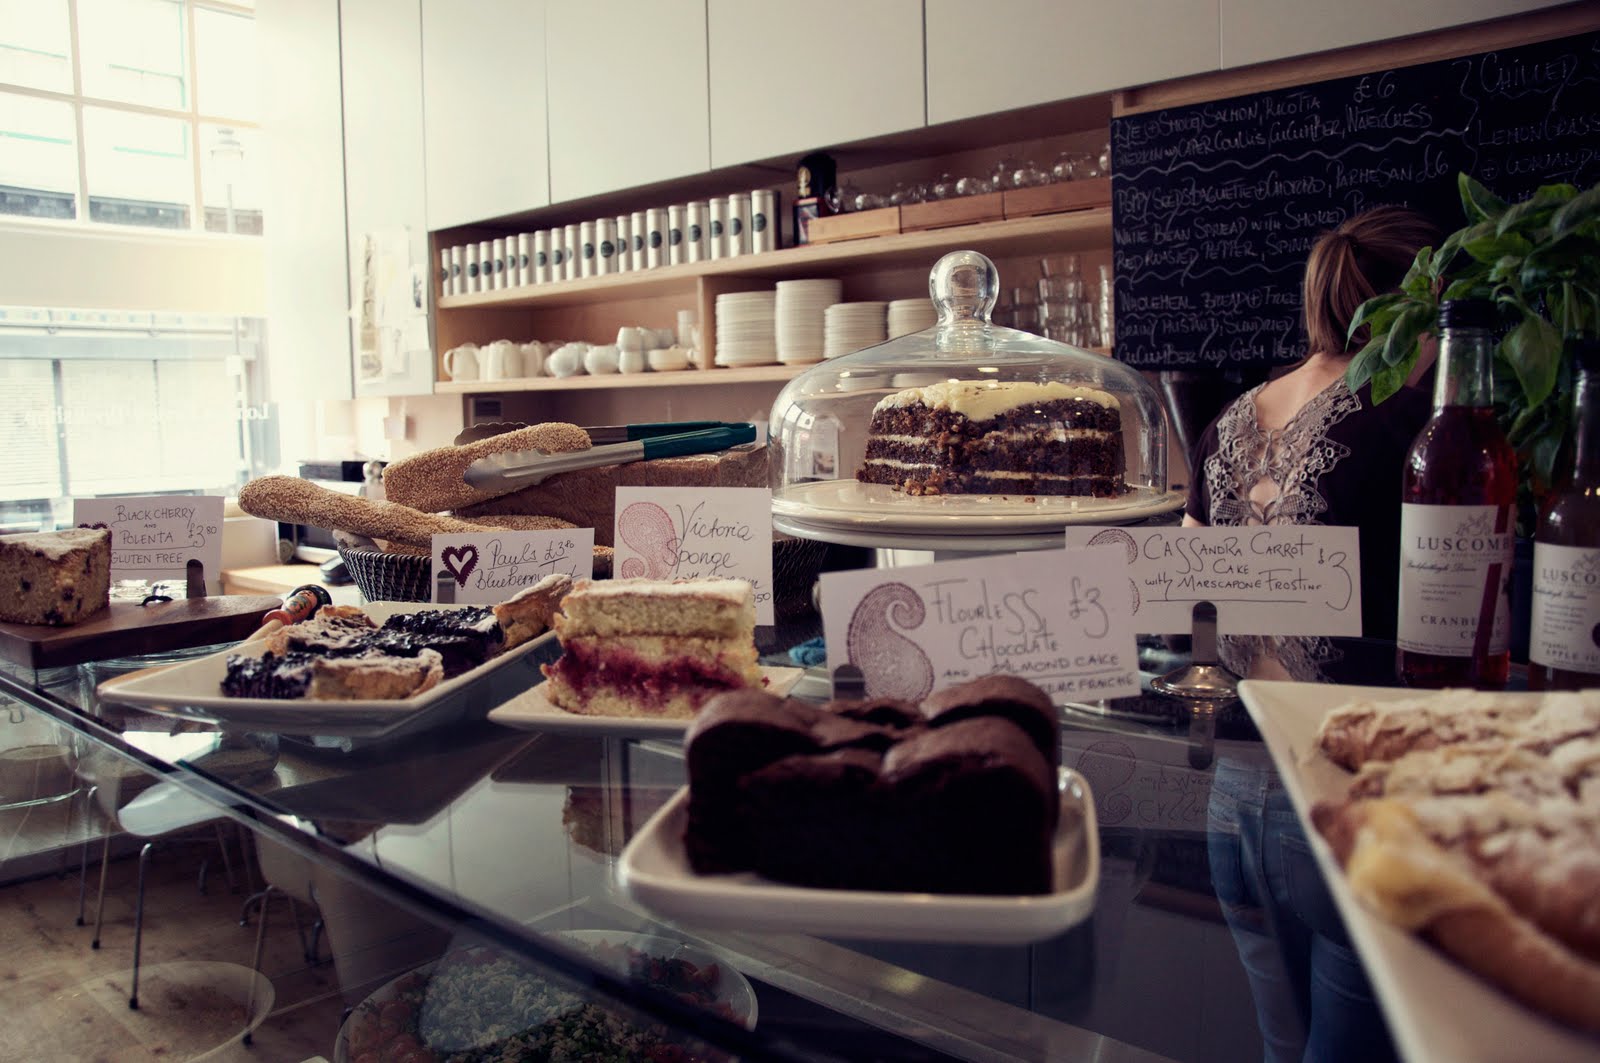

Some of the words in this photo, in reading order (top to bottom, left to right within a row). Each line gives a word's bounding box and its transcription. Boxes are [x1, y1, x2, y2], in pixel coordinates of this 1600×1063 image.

[154, 507, 195, 527] CHERRY
[676, 501, 754, 541] Victoria
[119, 530, 174, 545] POLENTA
[156, 552, 184, 564] FREE
[663, 537, 738, 575] Sponge
[1143, 533, 1243, 575] CASSANDRA
[1250, 532, 1314, 558] CARROT
[1212, 558, 1249, 575] CAKE
[1069, 576, 1110, 639] £3
[1075, 654, 1120, 668] CAKE
